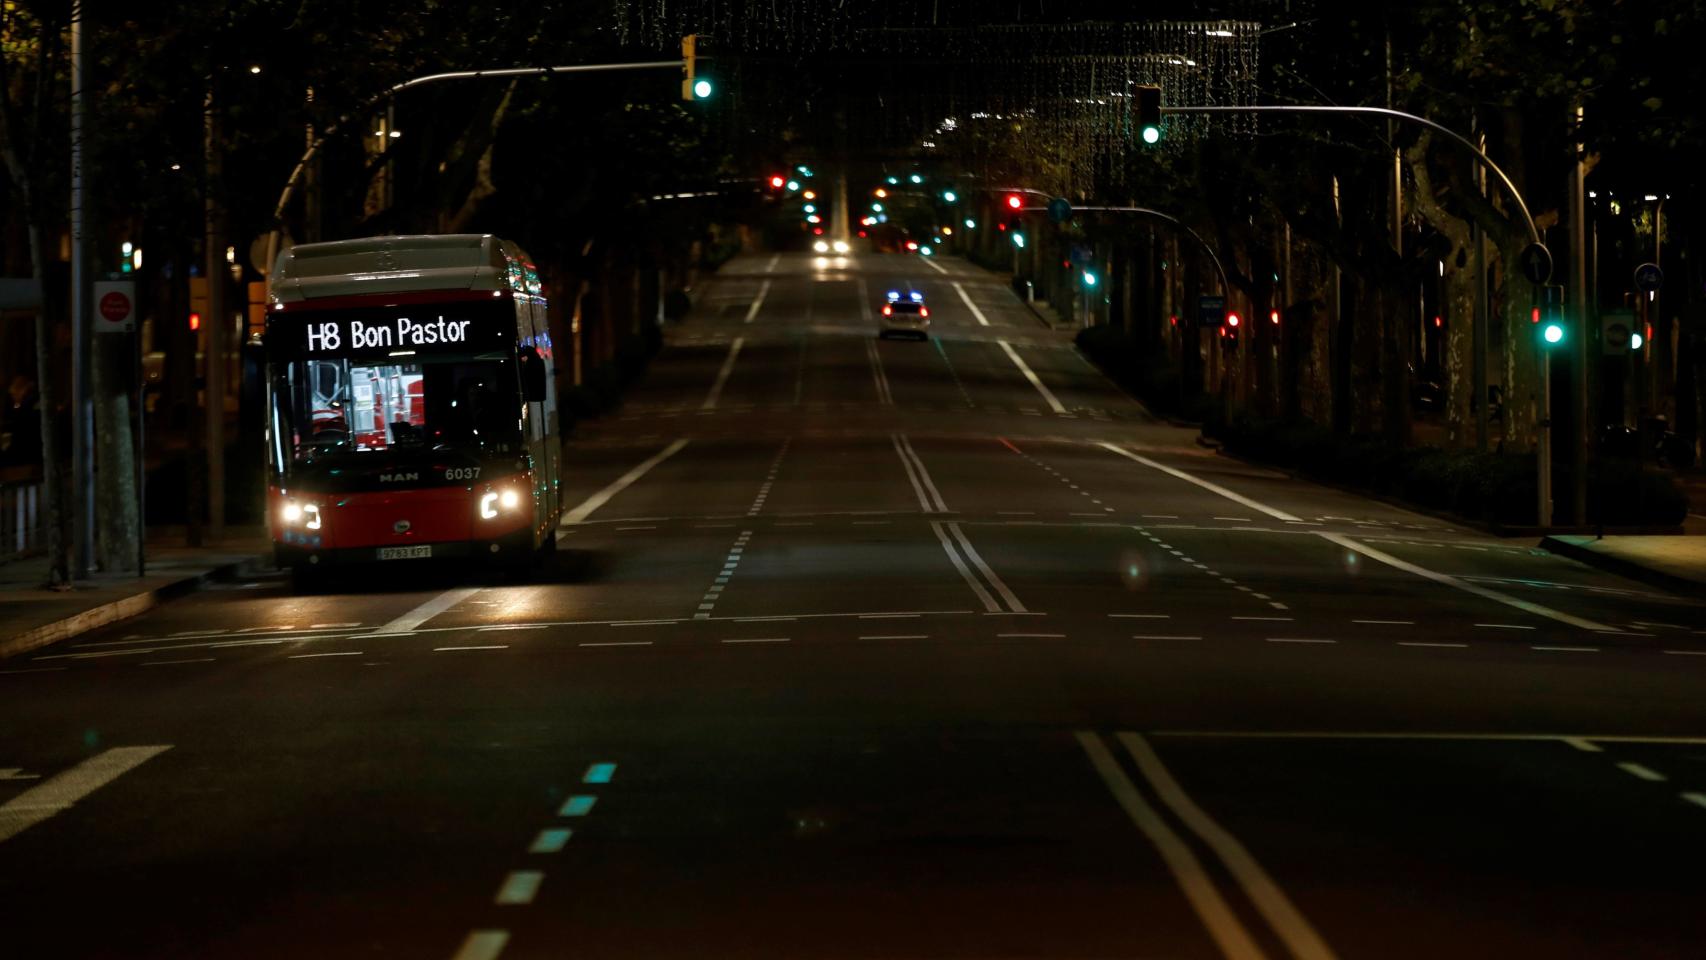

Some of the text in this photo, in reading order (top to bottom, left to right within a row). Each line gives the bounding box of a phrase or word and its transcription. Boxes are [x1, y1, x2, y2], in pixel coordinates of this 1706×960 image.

[308, 316, 470, 351] H8 Bon Pastor
[380, 472, 419, 482] MAN
[445, 467, 481, 480] 6037
